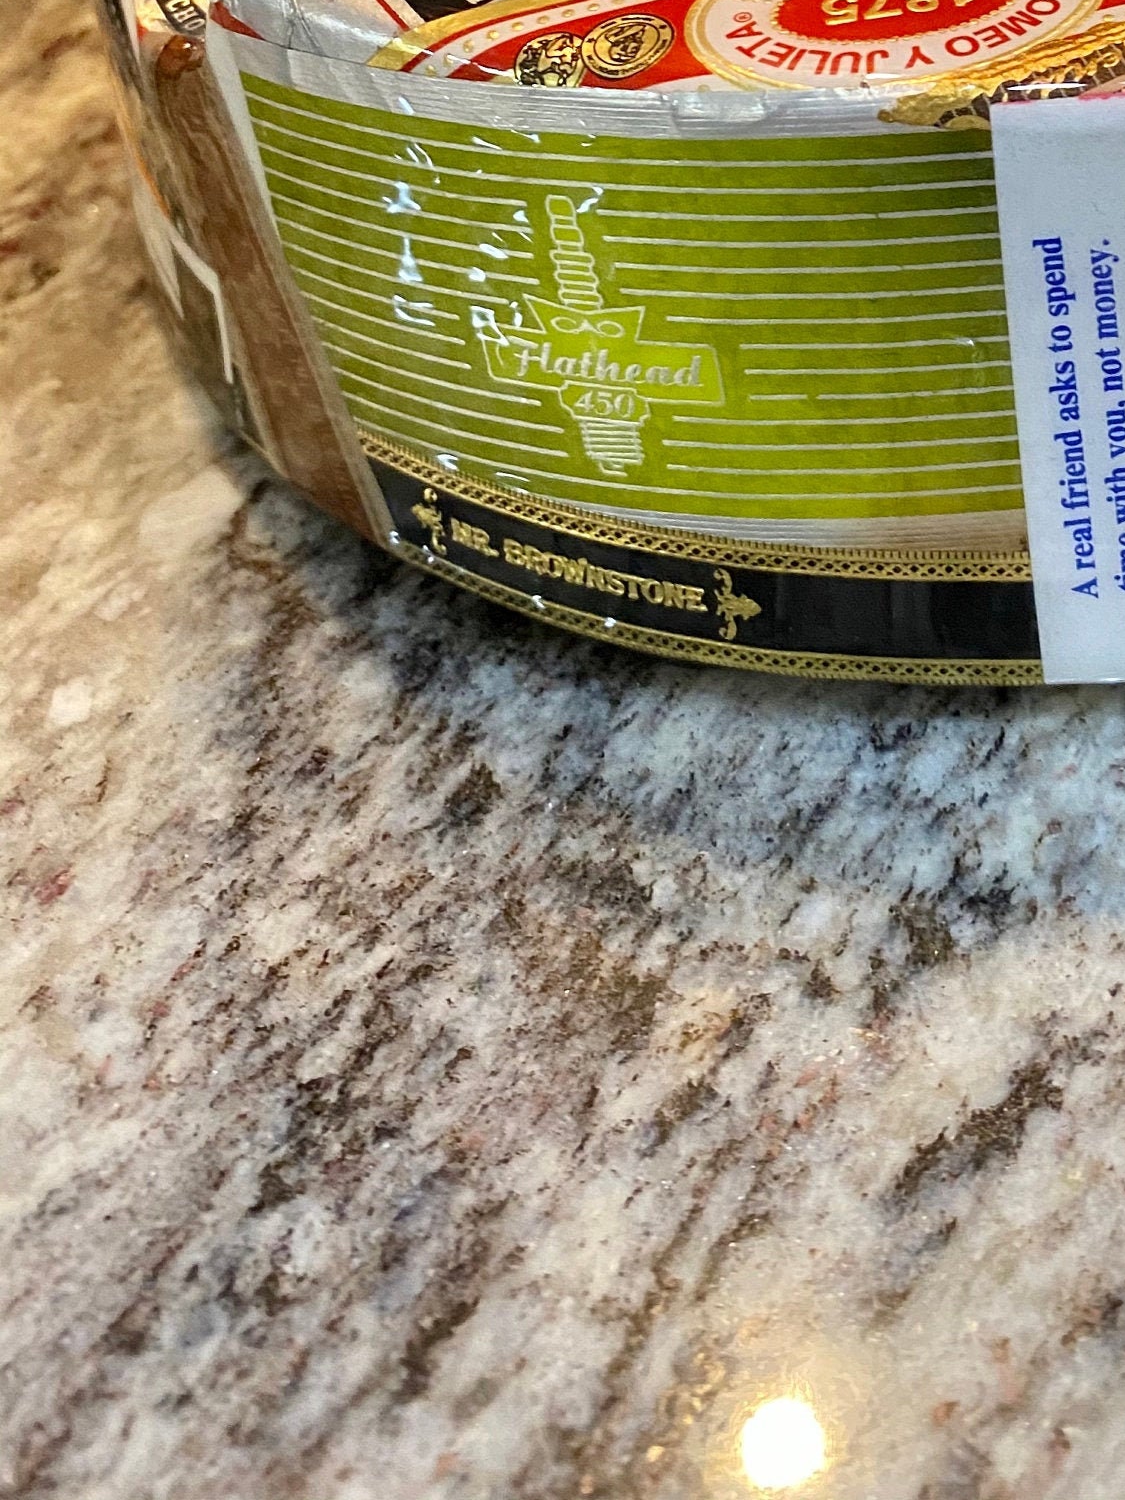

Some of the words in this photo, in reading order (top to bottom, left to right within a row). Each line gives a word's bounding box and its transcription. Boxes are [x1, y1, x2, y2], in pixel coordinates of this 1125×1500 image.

[904, 45, 934, 69] Y
[1032, 236, 1077, 317] spend
[1090, 238, 1120, 339] money.
[1047, 323, 1073, 354] to
[513, 341, 705, 387] Flathead
[1095, 347, 1124, 393] not
[574, 389, 635, 419] 450
[1049, 361, 1081, 422] asks
[1054, 429, 1090, 512] friend
[450, 517, 500, 558] MR.
[502, 537, 709, 613] BROWNSTONE
[1064, 516, 1096, 571] real
[1071, 577, 1099, 600] A
